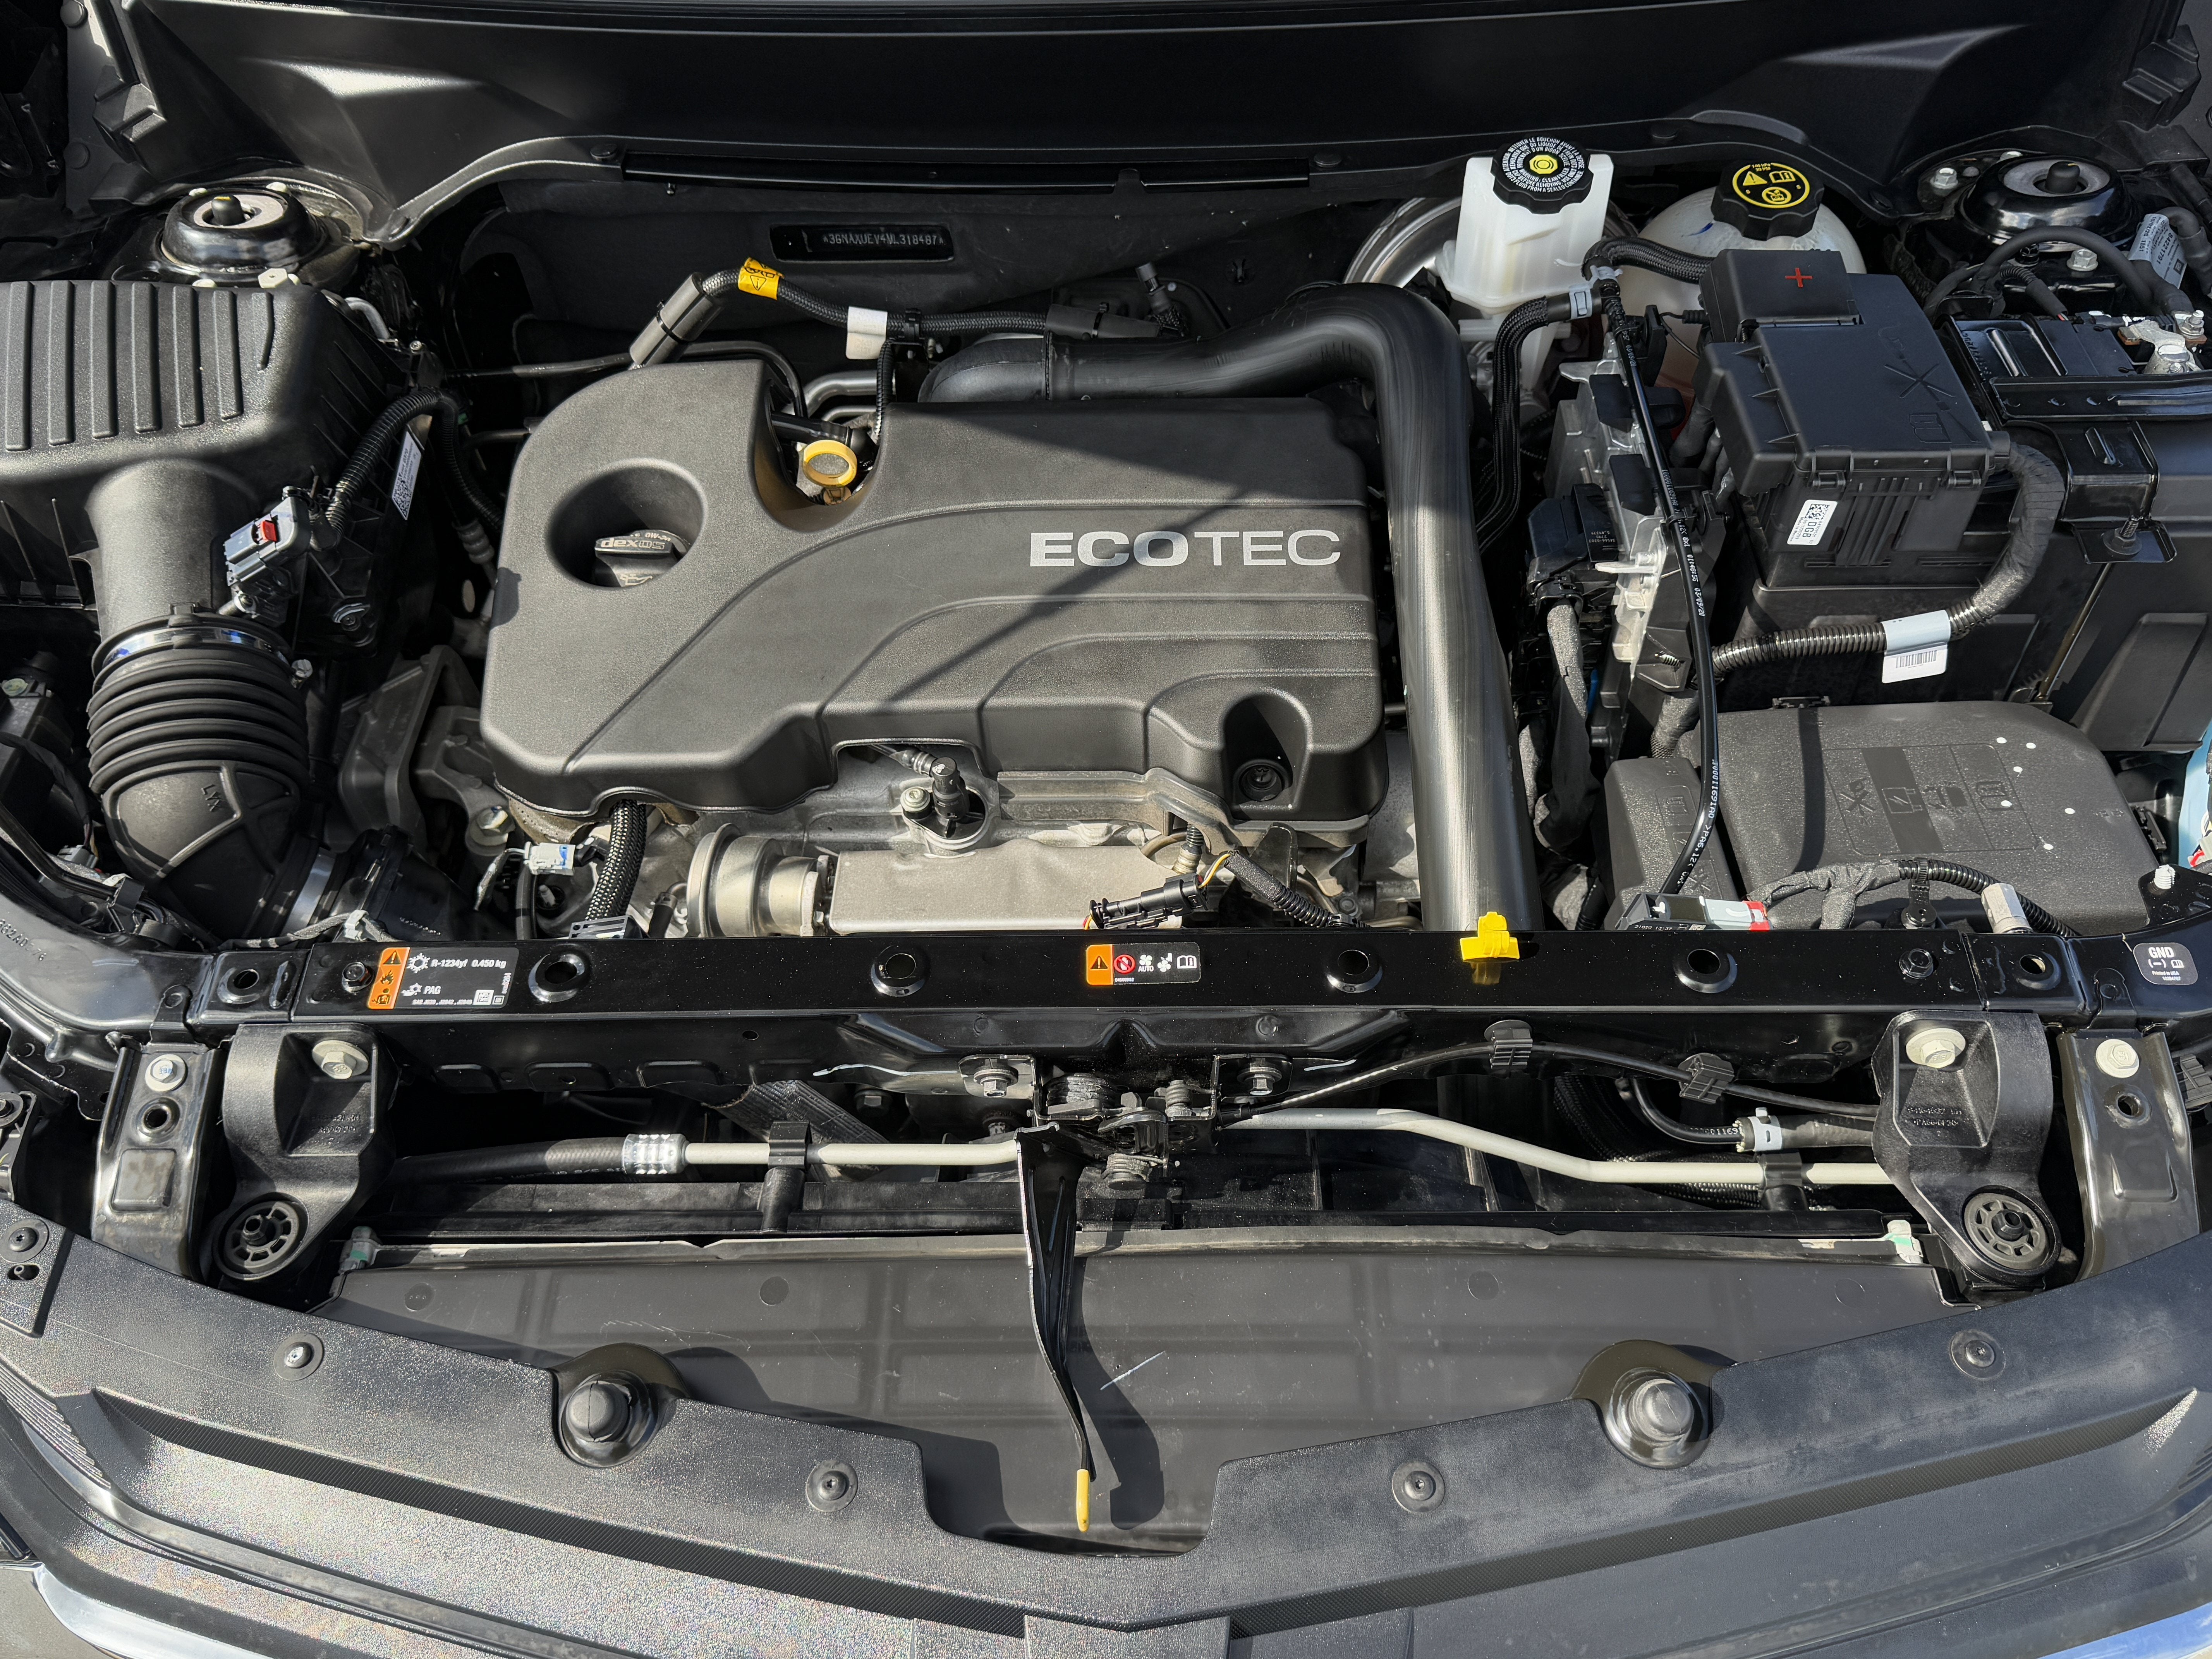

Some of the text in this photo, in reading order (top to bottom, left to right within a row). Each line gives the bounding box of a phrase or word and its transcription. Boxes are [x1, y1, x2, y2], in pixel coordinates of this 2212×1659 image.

[1559, 141, 1575, 151] AVANT
[1516, 175, 1536, 186] BEFORE
[2156, 232, 2173, 264] 84221791
[1802, 522, 1817, 537] DGB
[601, 538, 665, 550] dexos
[1030, 529, 1341, 567] ECOTEC
[2148, 947, 2174, 958] GND
[430, 959, 468, 968] R-1234yf
[495, 959, 507, 969] kg
[423, 986, 441, 994] PAG
